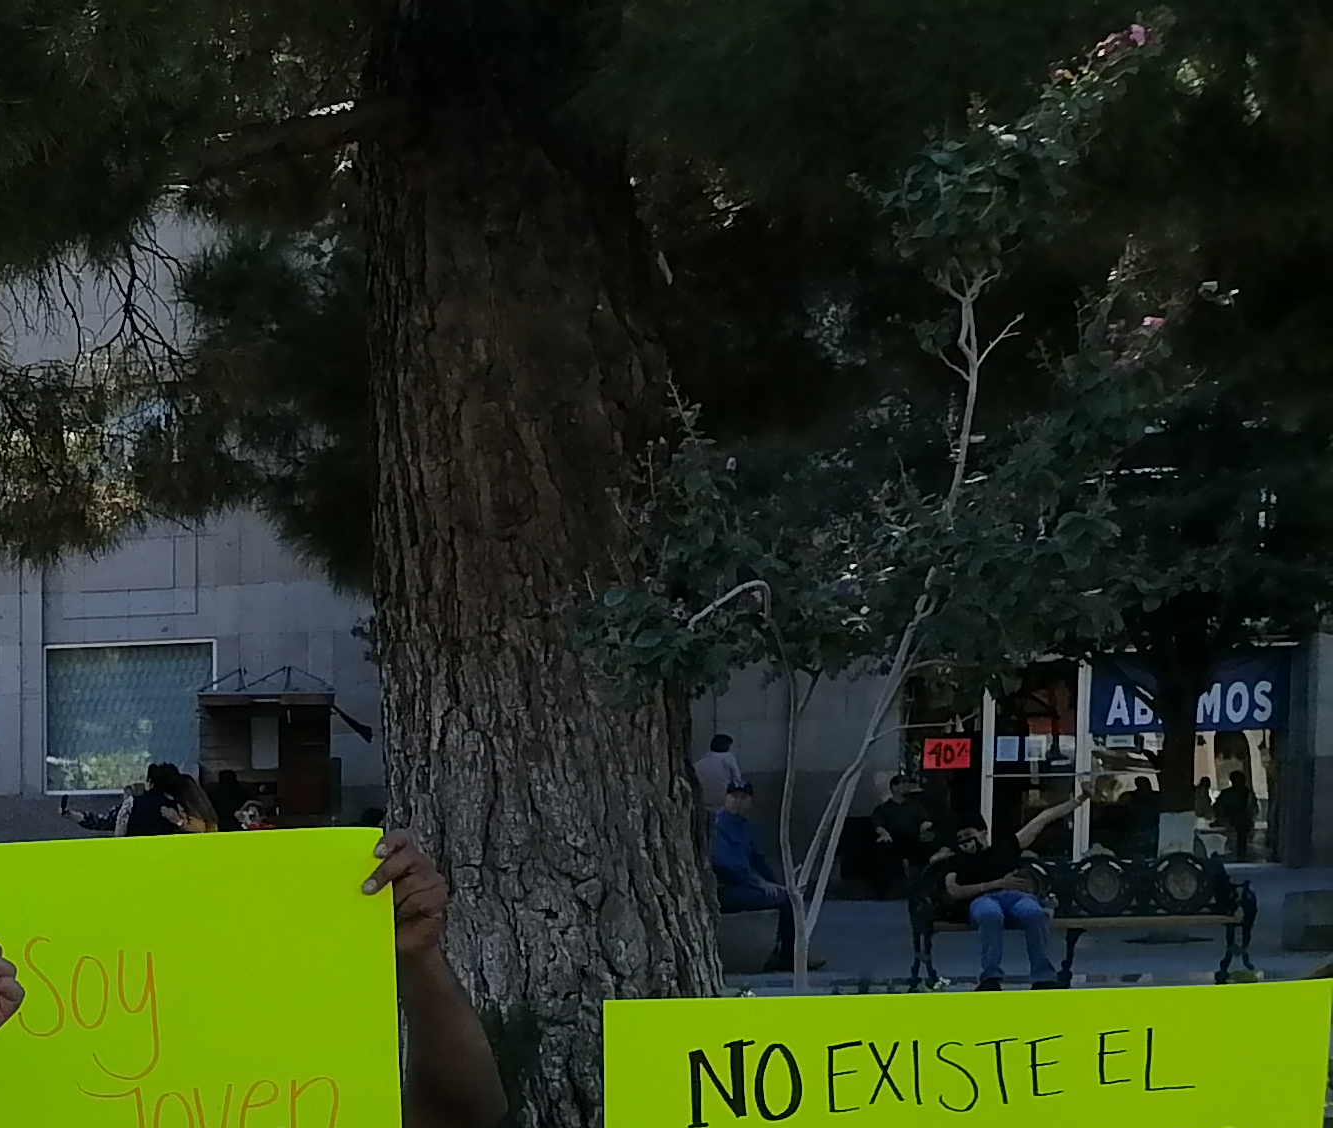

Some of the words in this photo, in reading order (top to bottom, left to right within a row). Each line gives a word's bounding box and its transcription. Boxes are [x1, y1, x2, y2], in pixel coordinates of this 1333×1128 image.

[17, 936, 161, 1081] Soy
[826, 1034, 1063, 1114] EXISTE
[1097, 1027, 1195, 1092] EL
